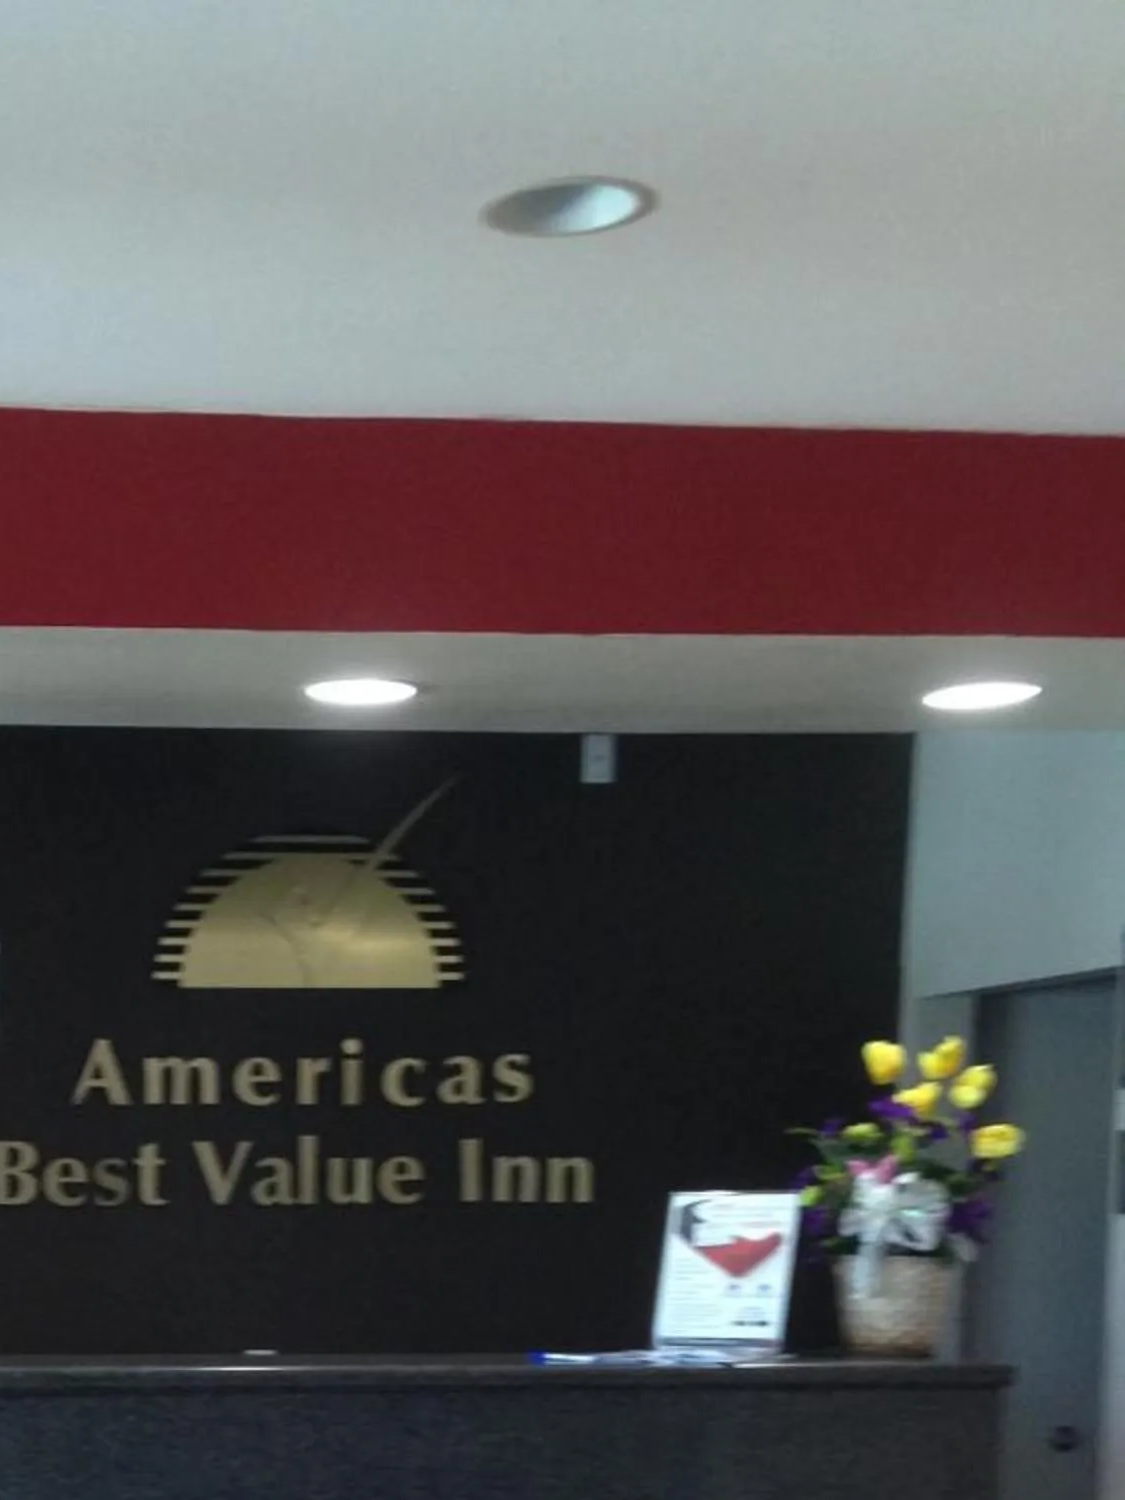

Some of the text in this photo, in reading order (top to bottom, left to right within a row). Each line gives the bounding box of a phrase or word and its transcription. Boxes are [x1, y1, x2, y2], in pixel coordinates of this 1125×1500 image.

[71, 1037, 534, 1106] Americas
[191, 1134, 425, 1206] Value
[458, 1137, 595, 1203] Inn
